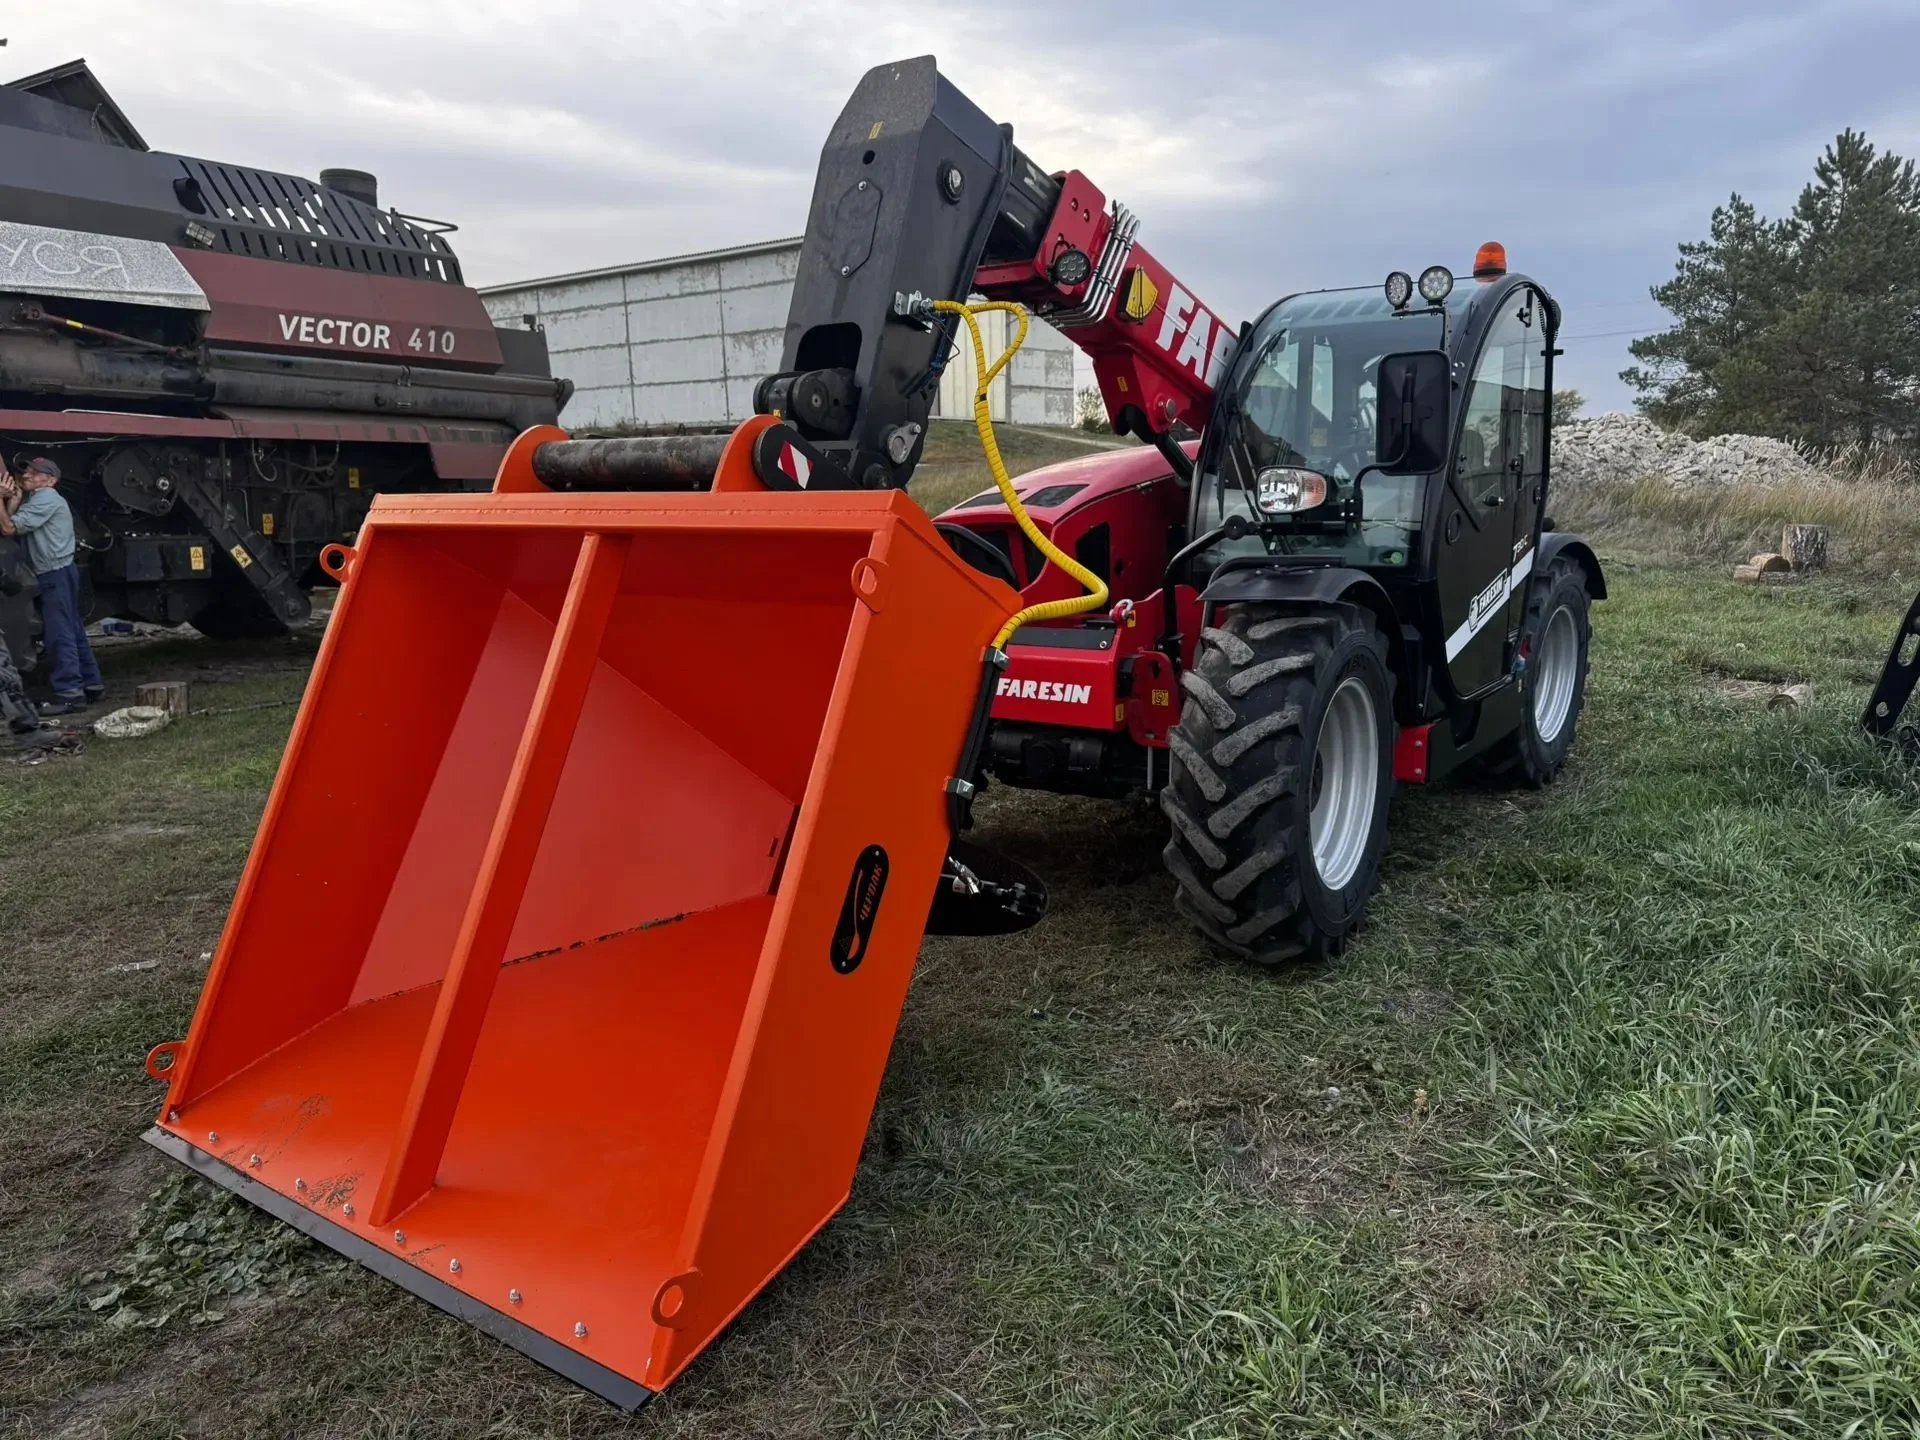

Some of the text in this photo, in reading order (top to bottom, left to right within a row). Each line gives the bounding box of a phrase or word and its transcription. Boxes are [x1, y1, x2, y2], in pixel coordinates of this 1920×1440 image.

[279, 314, 455, 353] VECTOR 410
[996, 677, 1092, 704] FARESIN
